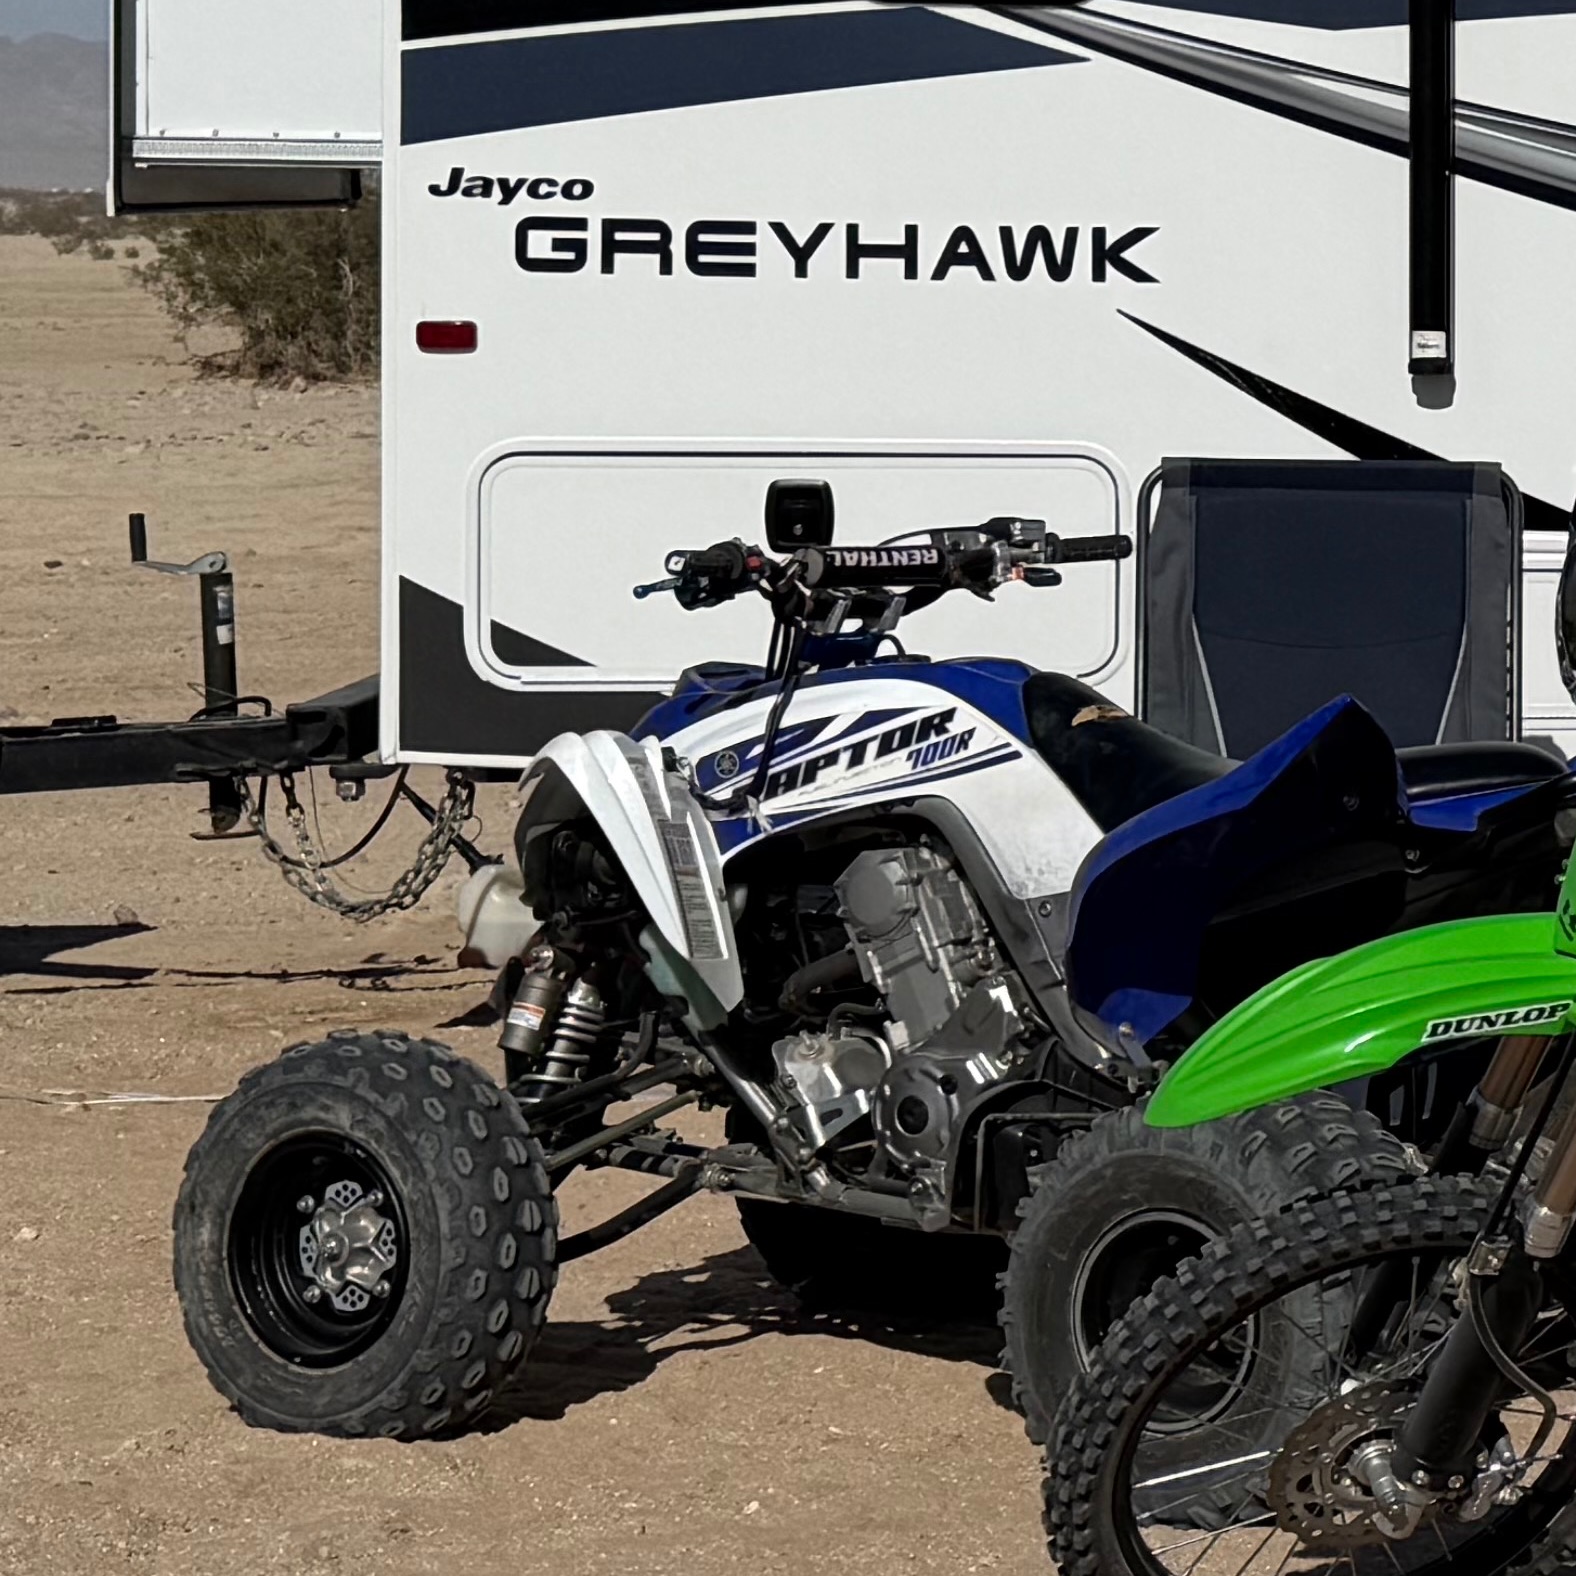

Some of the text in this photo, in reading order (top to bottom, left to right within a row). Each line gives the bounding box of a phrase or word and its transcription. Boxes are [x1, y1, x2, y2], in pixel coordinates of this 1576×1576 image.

[428, 167, 595, 205] Jayco
[514, 216, 1162, 283] GREYHAWK
[825, 549, 938, 566] RENTHAL
[750, 707, 958, 801] APTOR
[906, 727, 977, 770] 700R
[1424, 1002, 1573, 1040] DUNLOP
